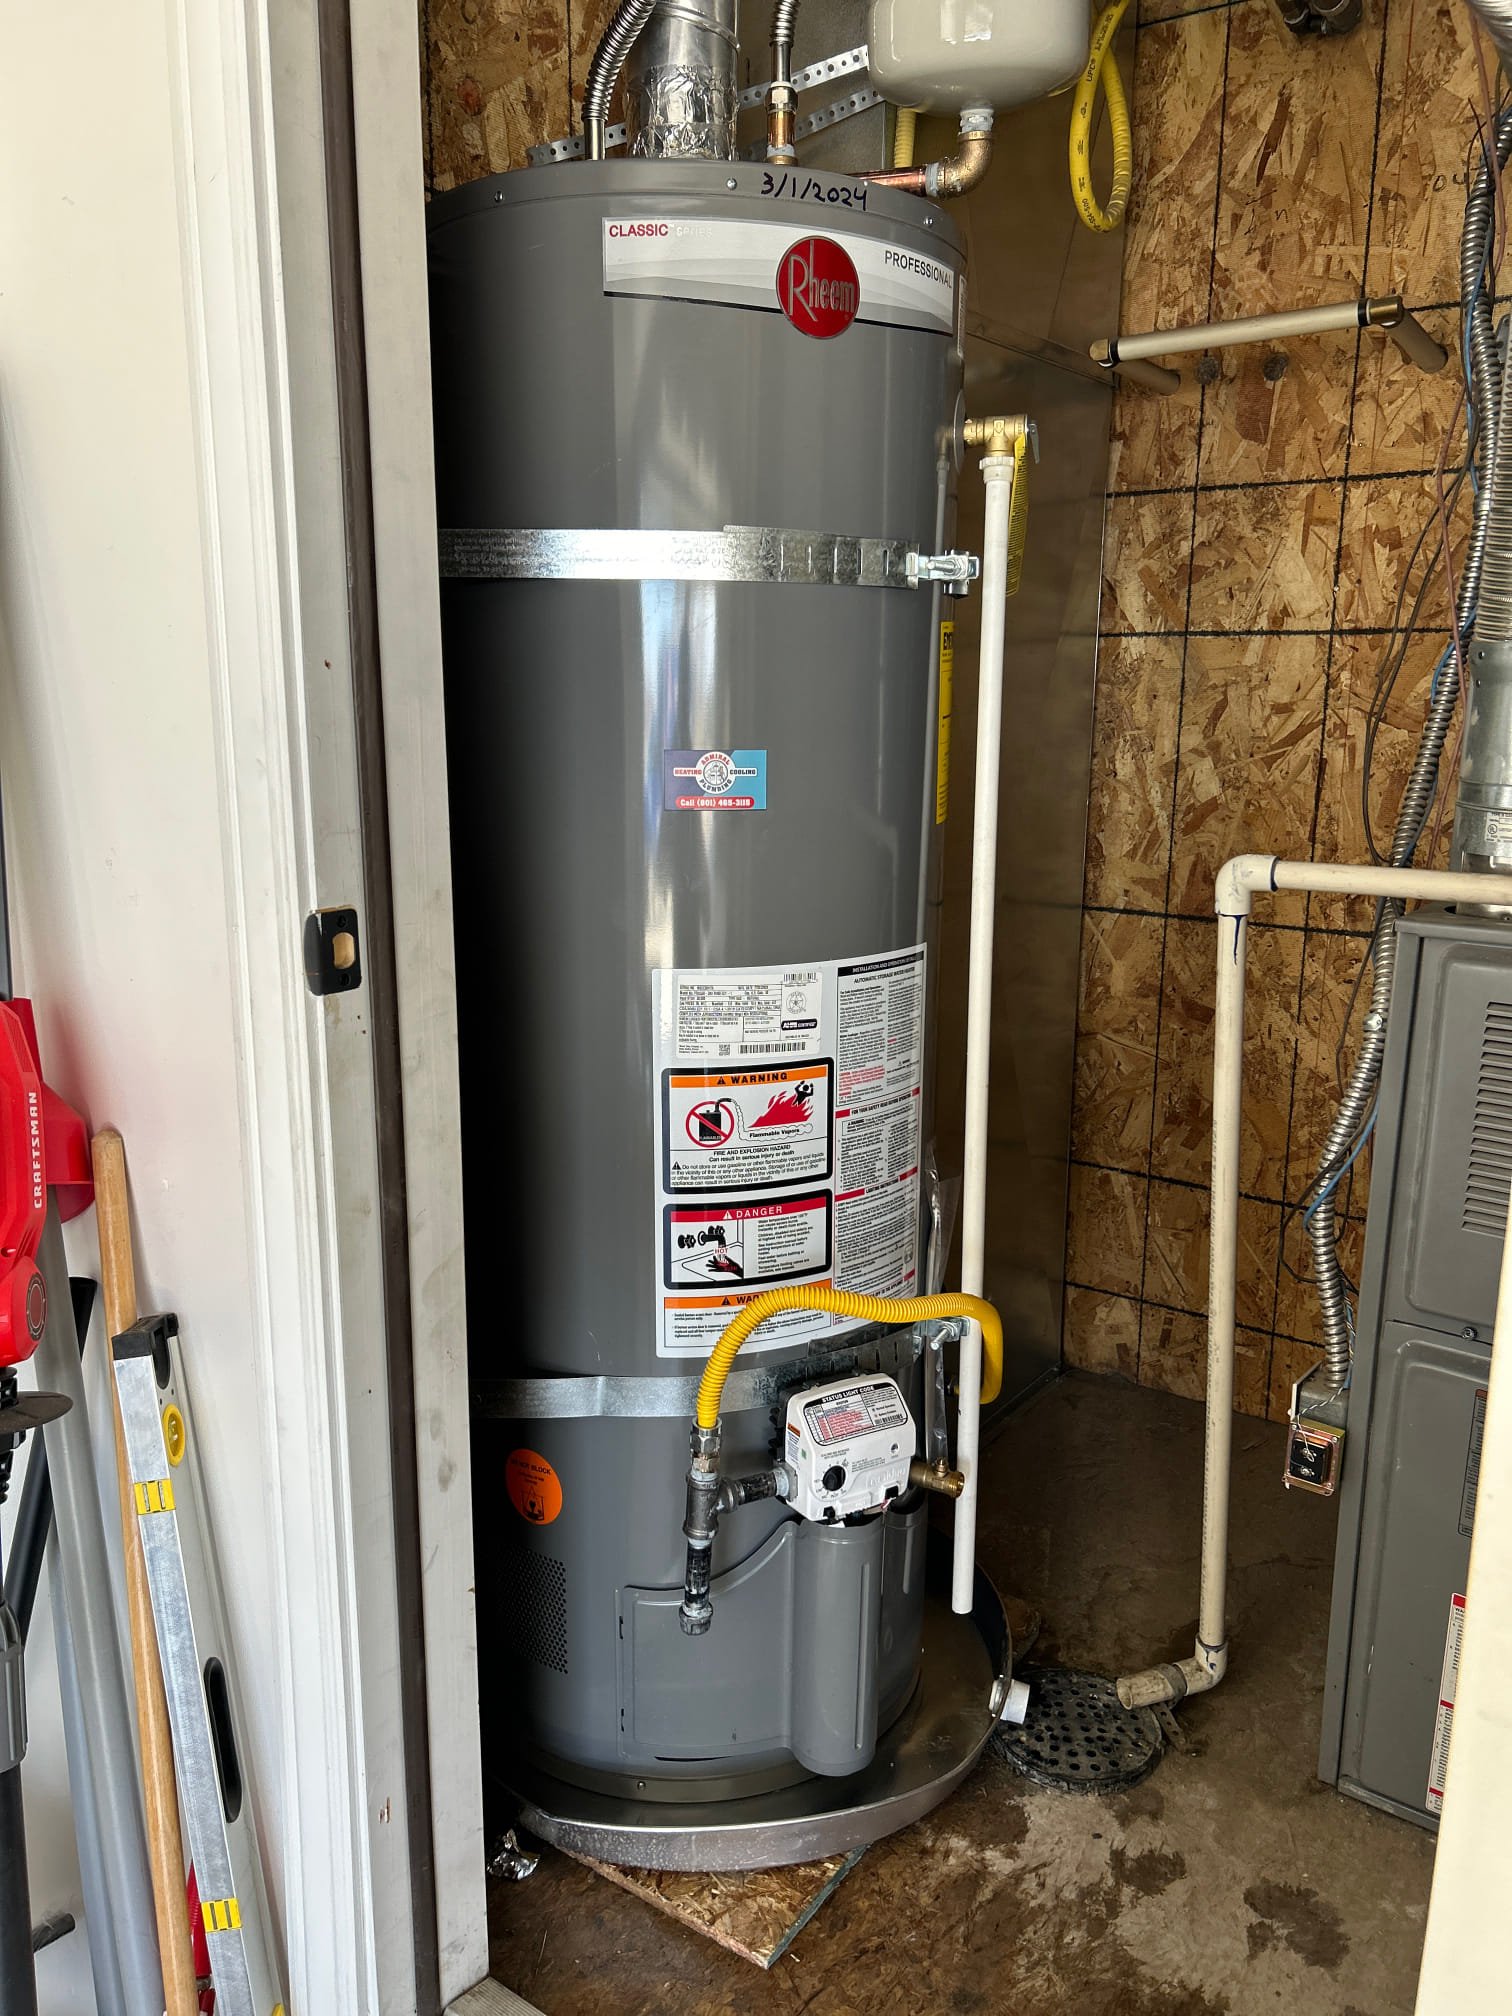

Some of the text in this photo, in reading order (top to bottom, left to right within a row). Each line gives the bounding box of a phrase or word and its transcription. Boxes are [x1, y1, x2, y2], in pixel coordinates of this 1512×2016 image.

[761, 172, 868, 211] 3/1/2024
[609, 224, 668, 237] CLASSIC
[884, 250, 953, 289] PROFESSIONAL
[787, 240, 855, 322] Rheem
[701, 753, 731, 766] ADMIRAL
[731, 1072, 788, 1084] WARNING
[782, 1128, 800, 1136] Vapors
[29, 1092, 42, 1209] CRAFTSMAN
[736, 1205, 783, 1219] DANGER
[822, 1394, 843, 1402] STATUS
[843, 1389, 859, 1398] LIGHT
